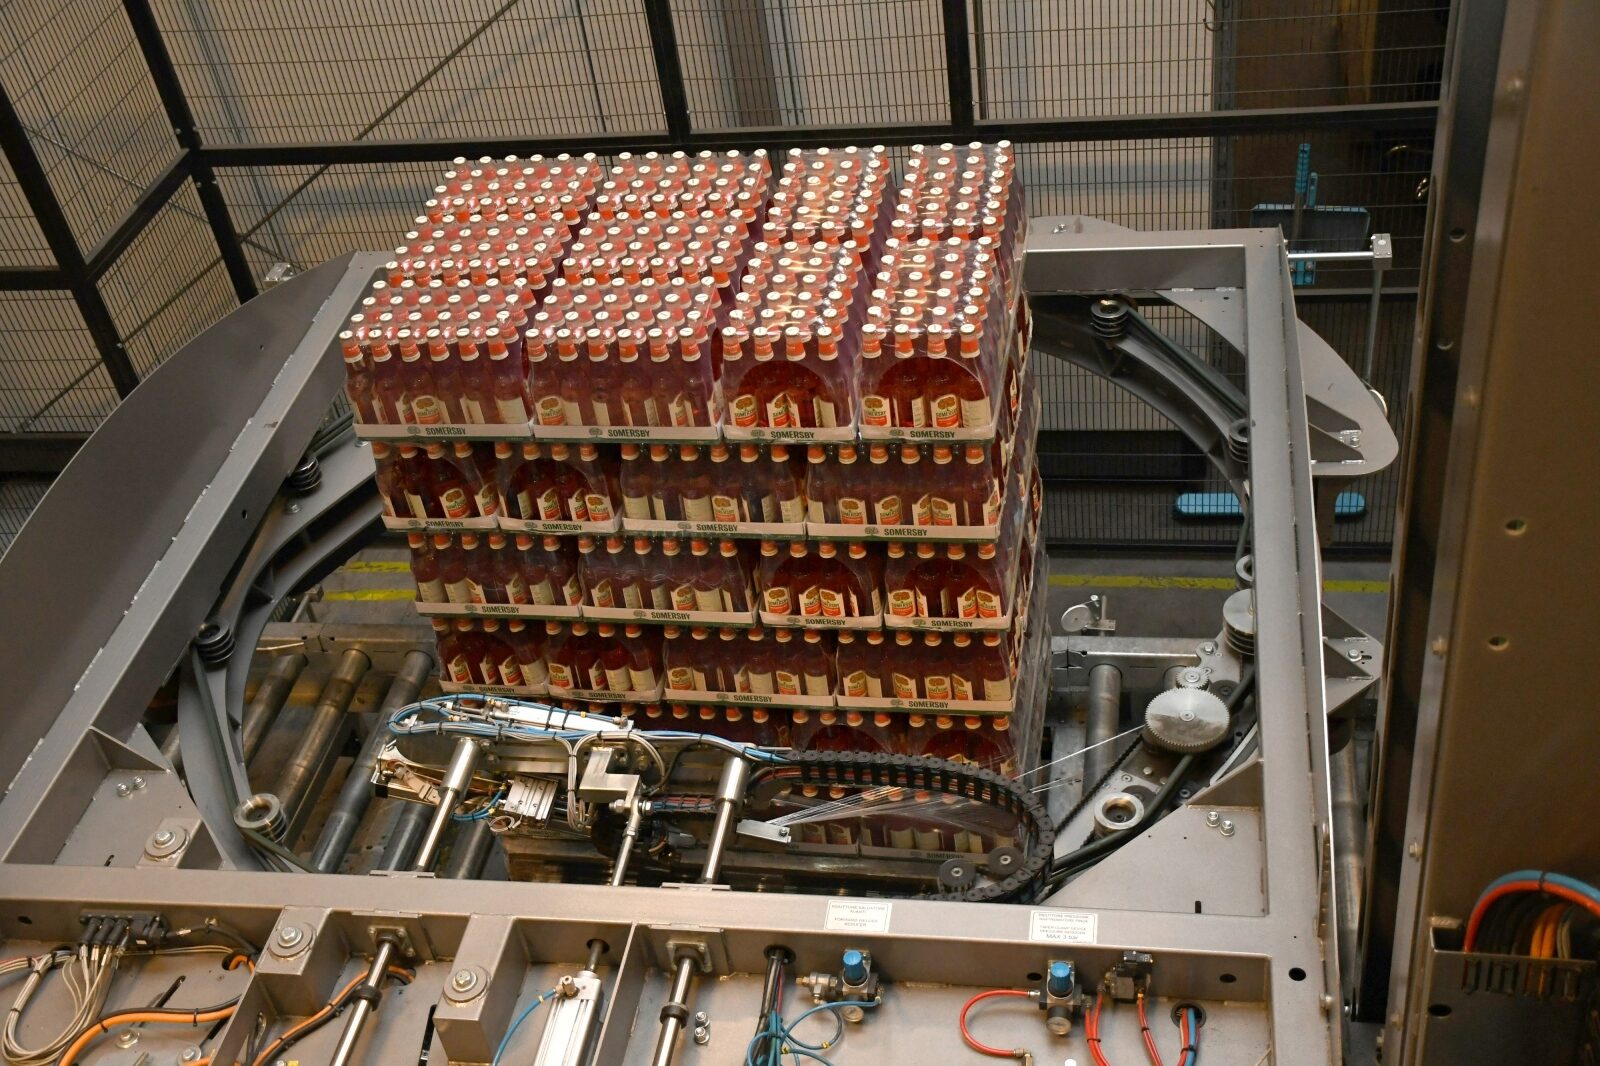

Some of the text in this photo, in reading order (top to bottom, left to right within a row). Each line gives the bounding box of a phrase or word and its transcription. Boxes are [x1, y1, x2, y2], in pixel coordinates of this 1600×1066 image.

[425, 427, 466, 436] SOMERSBY
[608, 429, 650, 438] SOMERSBY
[770, 430, 815, 440] SOMERSBY
[909, 430, 955, 439] SOMERSBY
[542, 523, 582, 531] SOMERSBY
[696, 523, 738, 532] SOMERSBY
[883, 528, 927, 536] SOMERSBY
[481, 605, 520, 614] SOMERSBY
[650, 611, 690, 620] SOMERSBY
[805, 618, 846, 626] SOMERSBY
[930, 620, 973, 628] SOMERSBY
[588, 691, 626, 700] SOMERSBY
[733, 695, 773, 703] SOMERSBY
[908, 700, 949, 709] SOMERSBY
